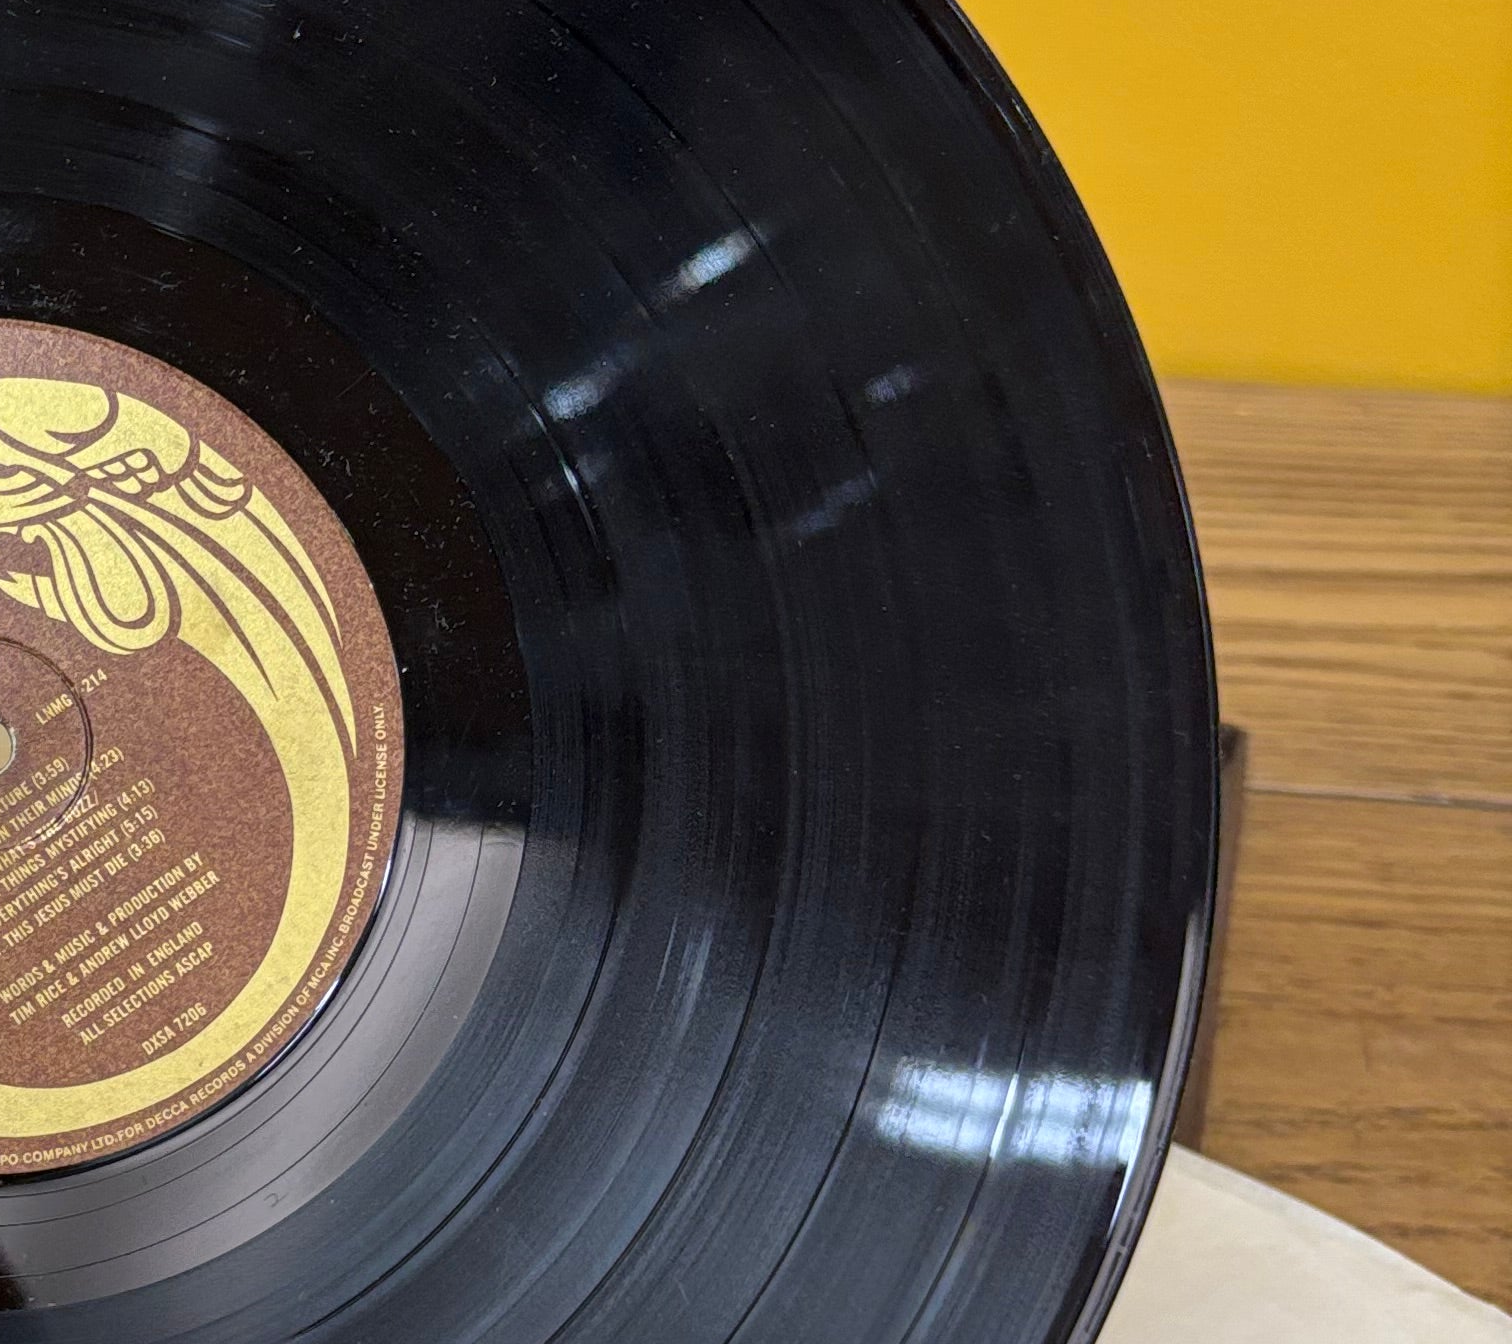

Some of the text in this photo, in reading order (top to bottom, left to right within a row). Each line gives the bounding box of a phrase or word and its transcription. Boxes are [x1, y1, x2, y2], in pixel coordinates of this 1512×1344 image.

[36, 694, 73, 725] LNMG
[0, 854, 46, 891] THINGS
[45, 803, 117, 859] MYSTIFYING
[9, 800, 48, 831] THEIR
[69, 829, 119, 873] ALRIGHT
[2, 920, 34, 947] THIS
[34, 894, 71, 927] JESUS
[69, 869, 104, 900] MUST
[104, 853, 128, 875] DIE
[42, 960, 56, 973] &
[54, 930, 95, 964] MUSIC
[95, 922, 109, 935] &
[108, 866, 185, 926] PRODUCTION
[183, 852, 203, 872] BY
[9, 871, 220, 1025] TIM RICE & ANDREW LLOYD WEBBER
[23, 1141, 88, 1163] COMPANY
[145, 1101, 189, 1129] DECCA
[189, 1060, 246, 1105] RECORDS
[246, 1052, 256, 1063] A
[253, 1005, 299, 1054] DIVISION
[296, 986, 310, 1005] OF
[307, 962, 331, 989] MCA
[338, 853, 374, 934] BROADCAST
[366, 803, 384, 850] UNDER
[375, 744, 387, 799] LICENSE
[61, 921, 203, 1028] RECORDED IN ENGLAND
[79, 942, 212, 1045] ALL SELECTIONS ASCAP
[142, 1002, 207, 1055] DXSA 7206
